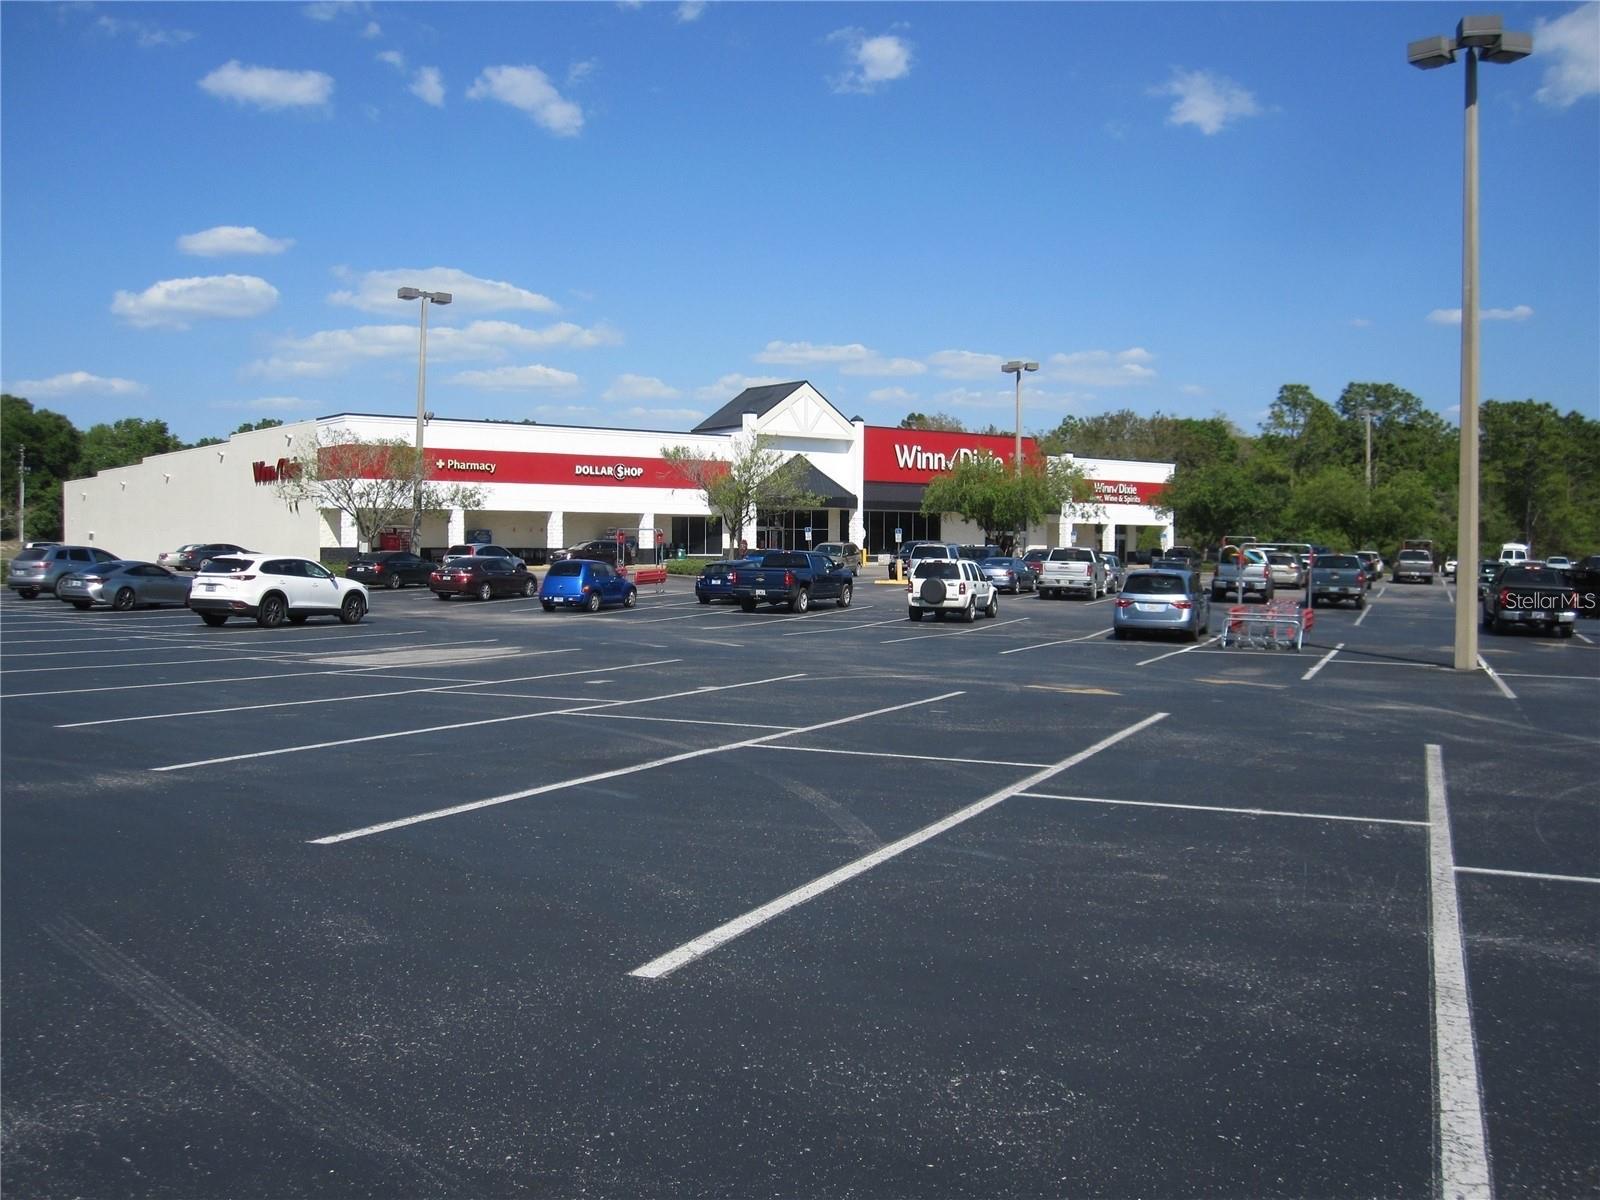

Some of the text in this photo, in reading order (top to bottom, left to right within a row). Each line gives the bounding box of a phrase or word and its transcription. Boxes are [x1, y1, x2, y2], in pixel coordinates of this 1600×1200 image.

[894, 443, 946, 471] Winn
[447, 458, 497, 474] Pharmacy
[575, 465, 613, 476] DOLLAR
[1094, 482, 1138, 495] Winn Dixie
[1104, 494, 1118, 502] Wine
[1123, 495, 1141, 504] Spirits
